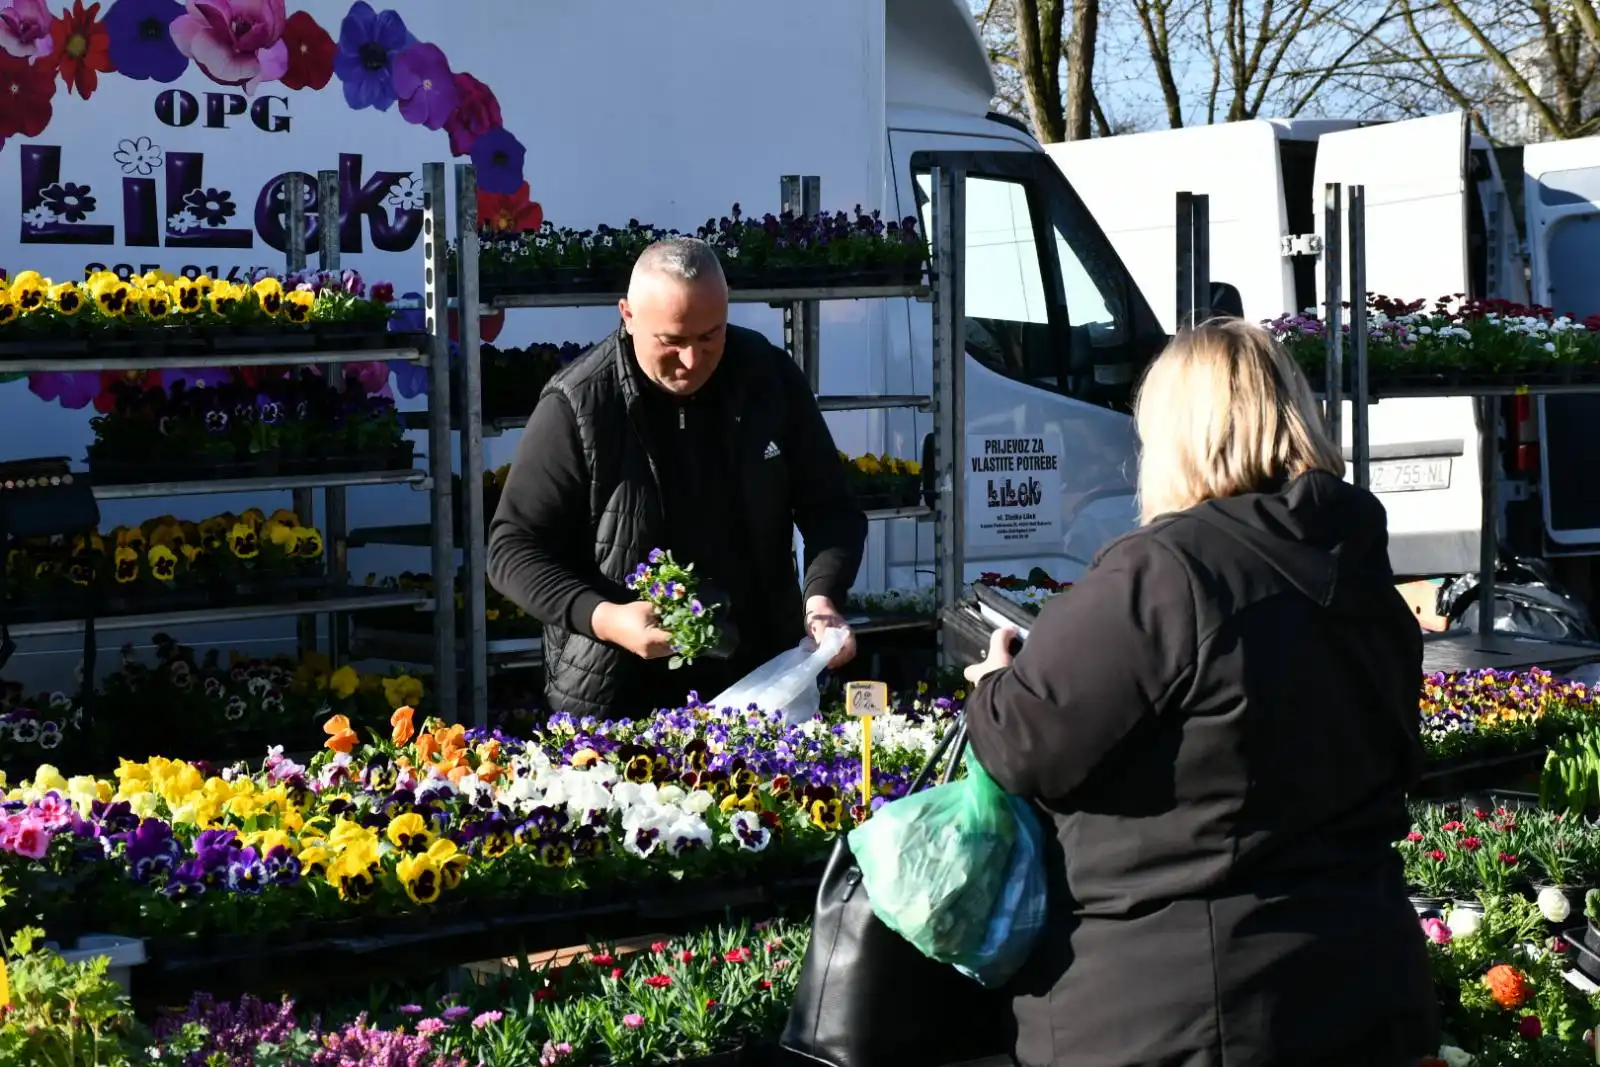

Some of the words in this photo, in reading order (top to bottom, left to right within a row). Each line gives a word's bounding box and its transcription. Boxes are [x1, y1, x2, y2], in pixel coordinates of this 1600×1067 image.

[154, 89, 292, 133] OPG
[985, 440, 1030, 453] PRIJEVOZ
[1032, 438, 1044, 453] ZA
[972, 457, 1014, 472] VLASTITE
[1017, 455, 1057, 471] POTREBE
